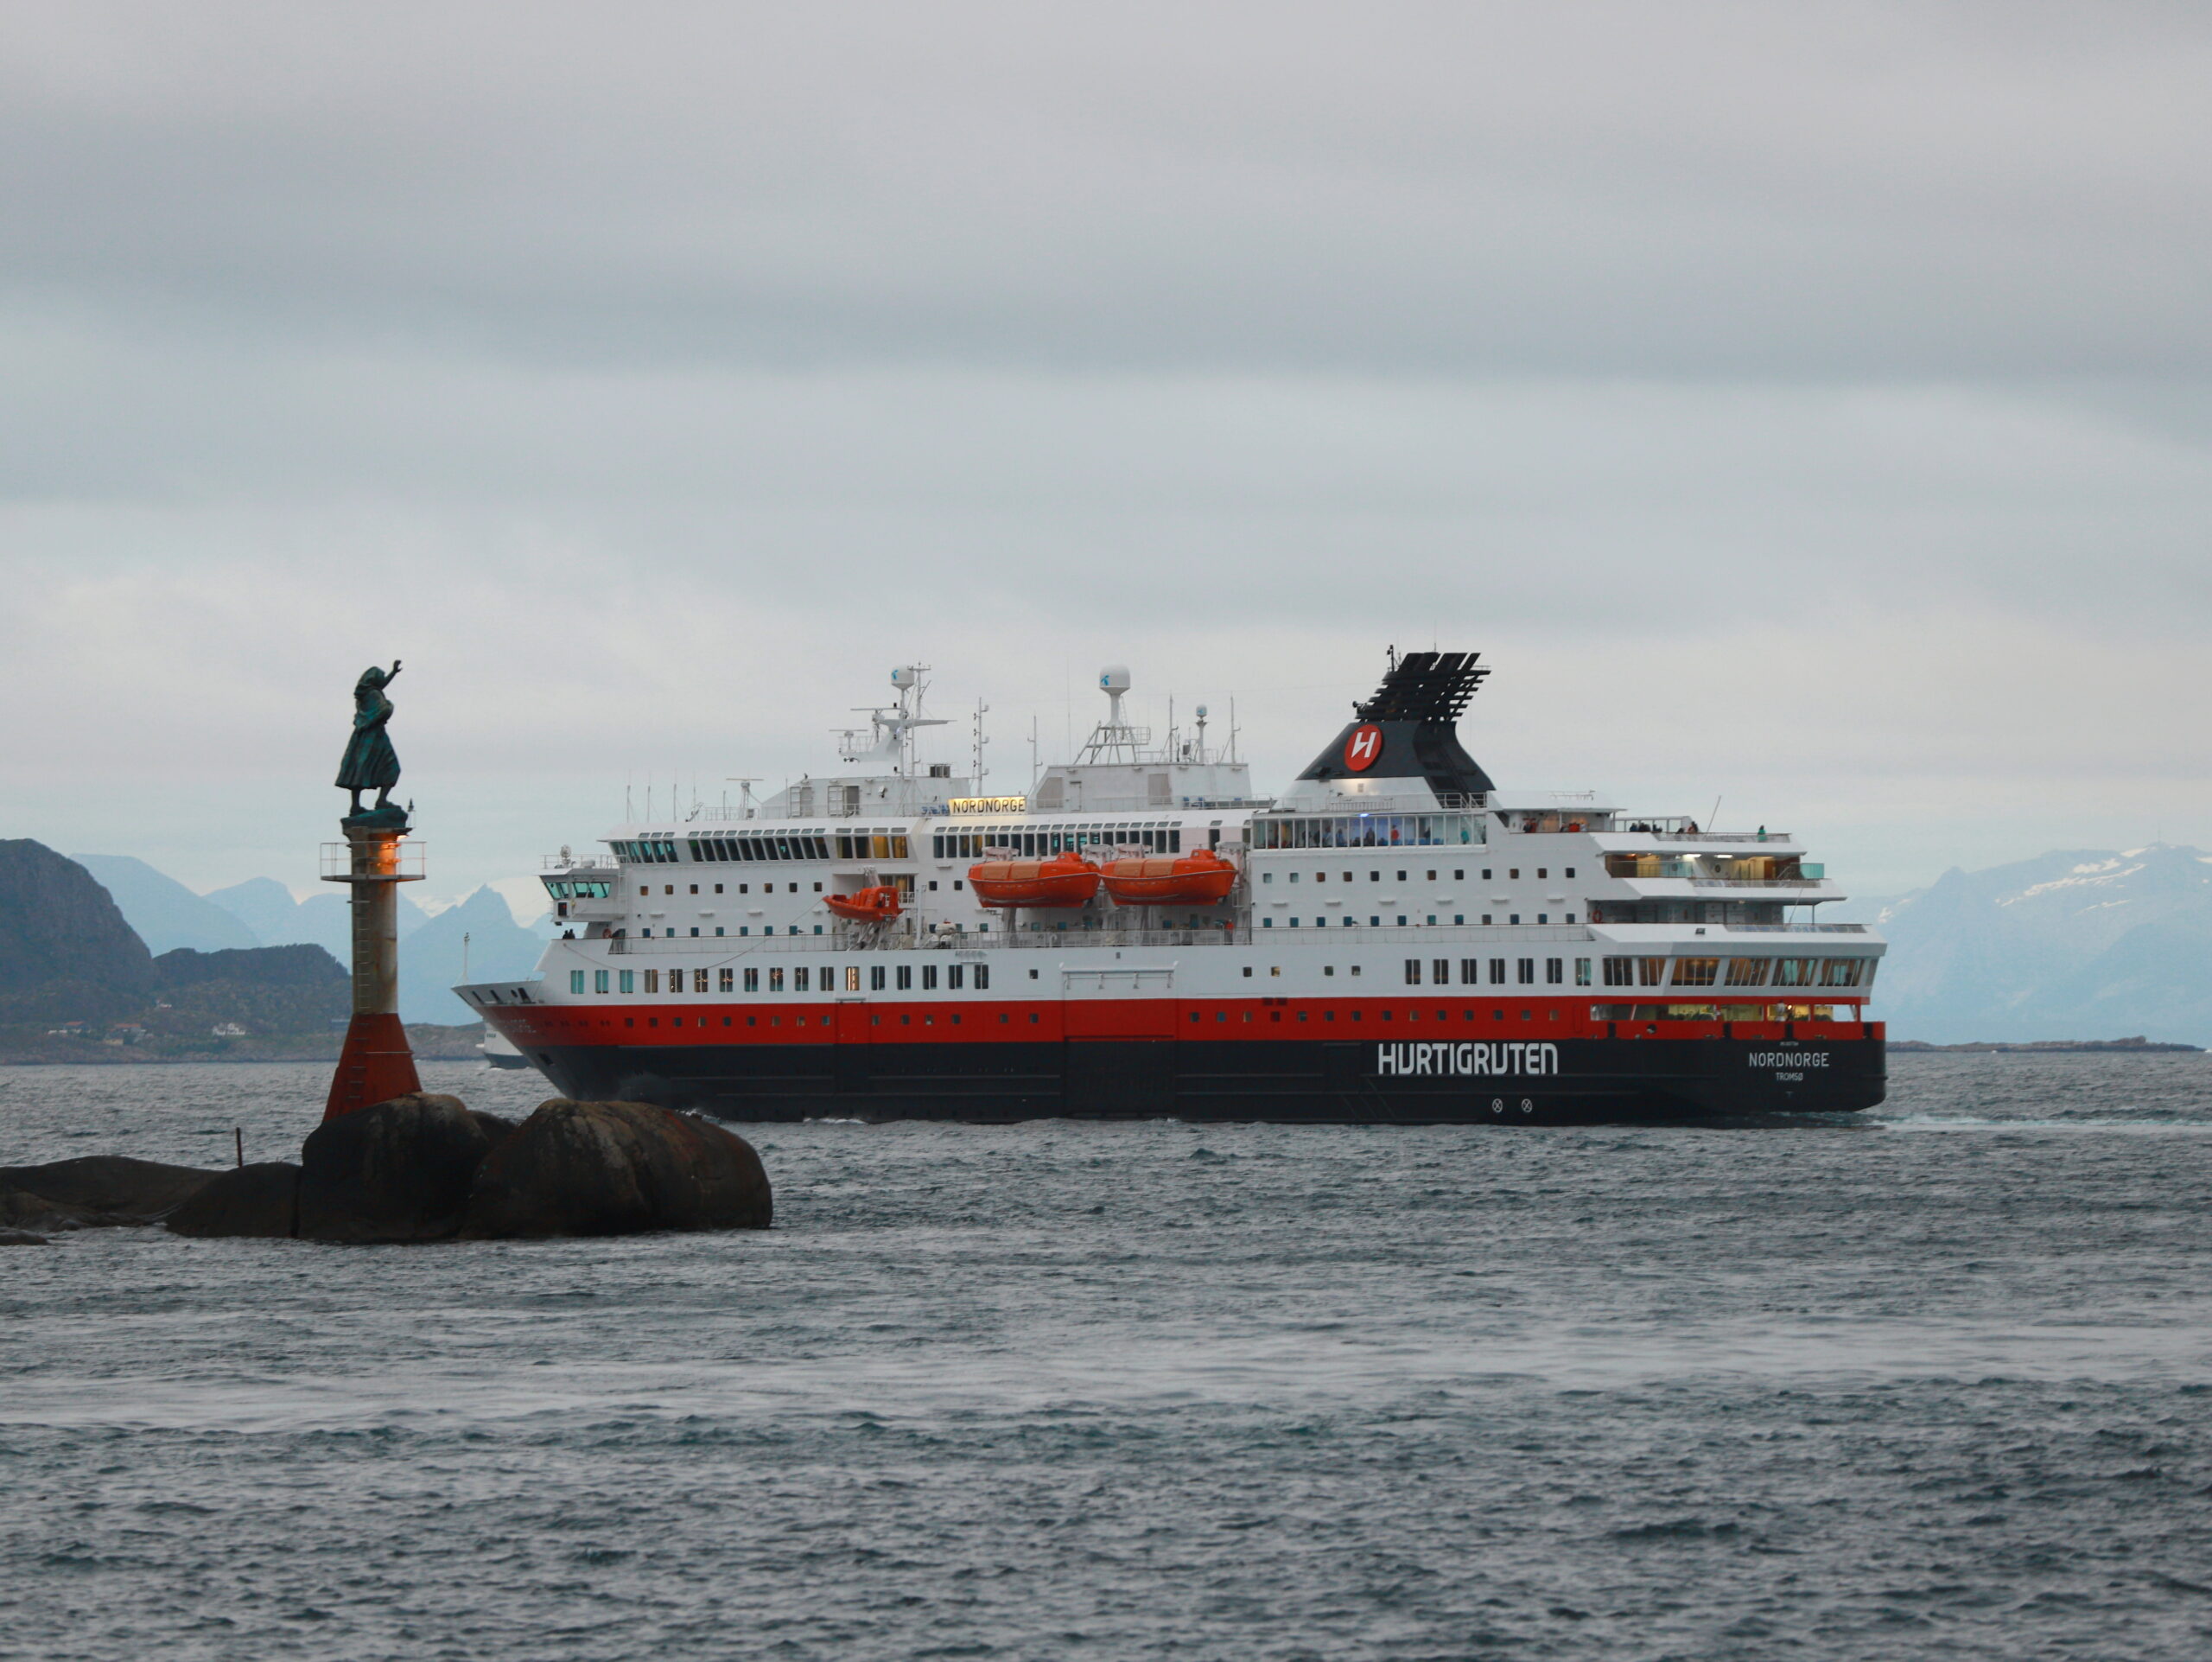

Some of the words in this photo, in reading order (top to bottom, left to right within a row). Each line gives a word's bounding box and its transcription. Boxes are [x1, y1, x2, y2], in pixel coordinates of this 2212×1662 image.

[1351, 731, 1377, 758] H
[953, 799, 1026, 814] NORDNORGE
[1378, 1042, 1559, 1075] HURTIGRUTEN
[1749, 1052, 1830, 1067] NORDNORGE
[1776, 1072, 1803, 1082] TROMSØ
